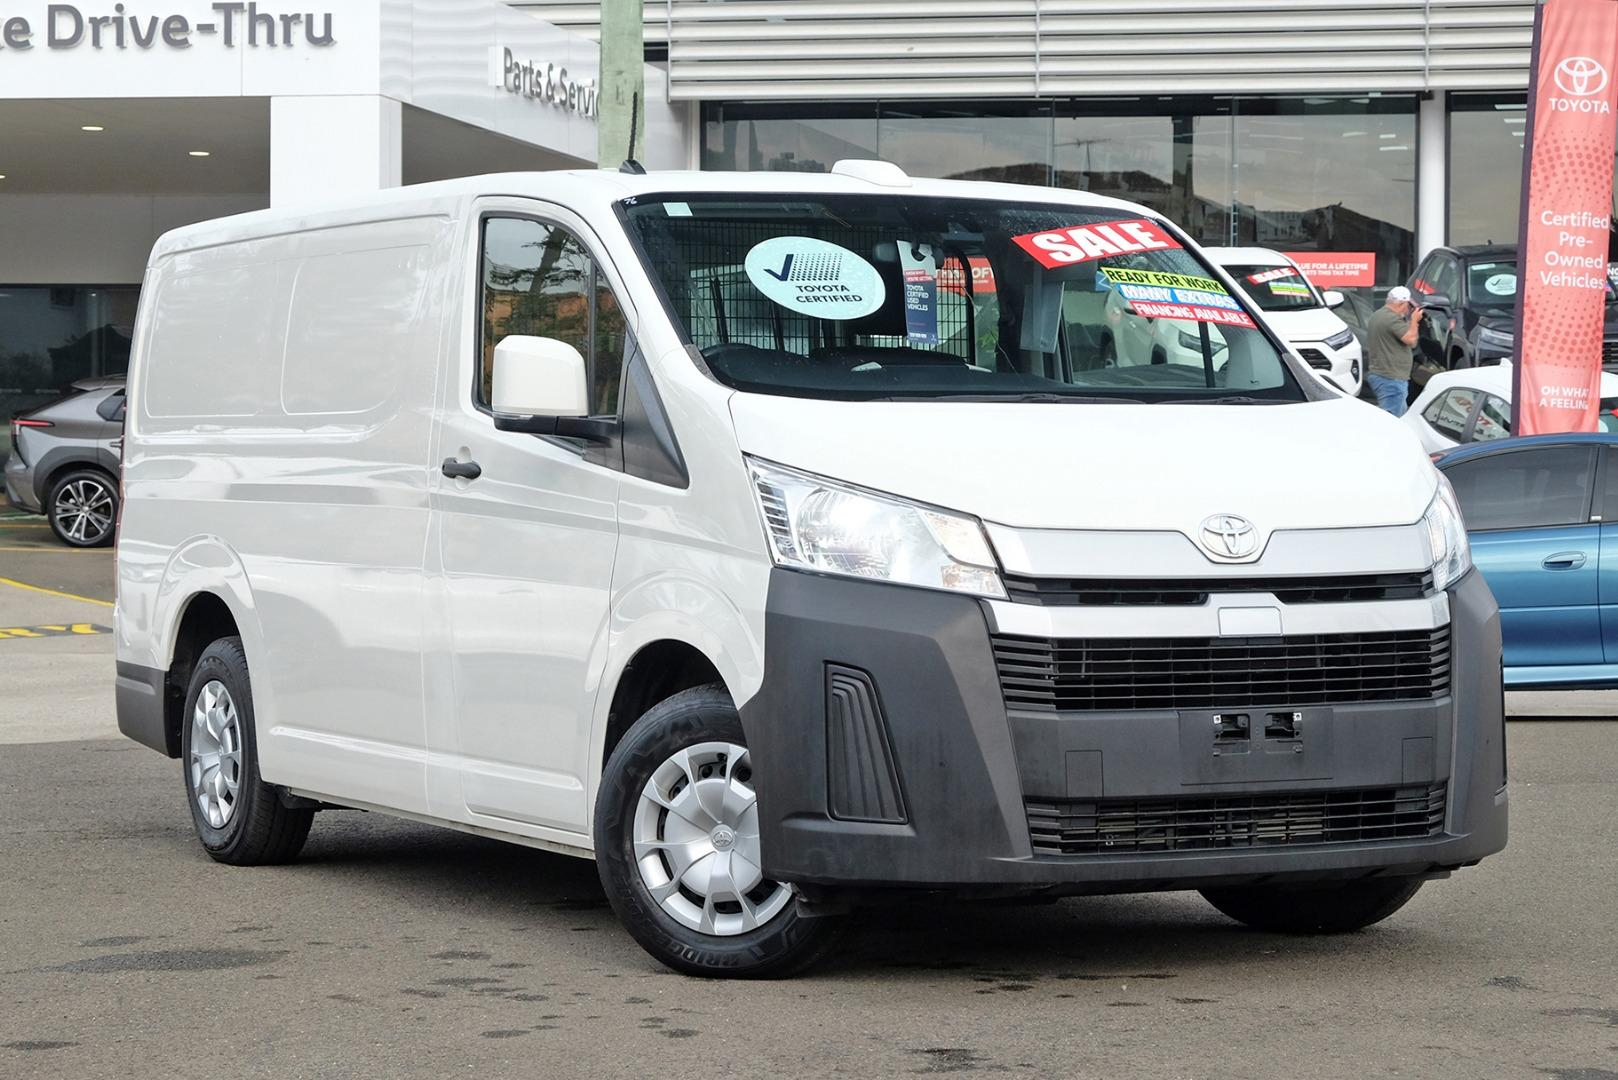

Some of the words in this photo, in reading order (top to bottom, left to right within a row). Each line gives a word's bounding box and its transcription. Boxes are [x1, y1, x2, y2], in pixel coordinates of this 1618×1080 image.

[0, 16, 32, 49] e
[48, 2, 335, 49] Drive-Thru
[504, 47, 542, 98] Parts
[546, 63, 556, 101] &
[1549, 97, 1610, 114] TOYOTA
[1541, 210, 1609, 229] Certified
[1031, 222, 1169, 263] SALE
[1559, 231, 1593, 247] Pre-
[1544, 251, 1603, 269] Owned
[795, 284, 850, 293] TOYOTA
[1106, 270, 1150, 283] READY
[1154, 274, 1182, 286] FOR
[1183, 277, 1224, 292] WORK
[1540, 271, 1604, 290] Vehicles
[796, 294, 863, 303] CERTIFIED
[1119, 284, 1173, 301] MANY
[1133, 303, 1195, 319] FINANCING
[1194, 307, 1251, 324] AVAILABLE
[1541, 386, 1560, 396] OH
[1539, 398, 1548, 408] A
